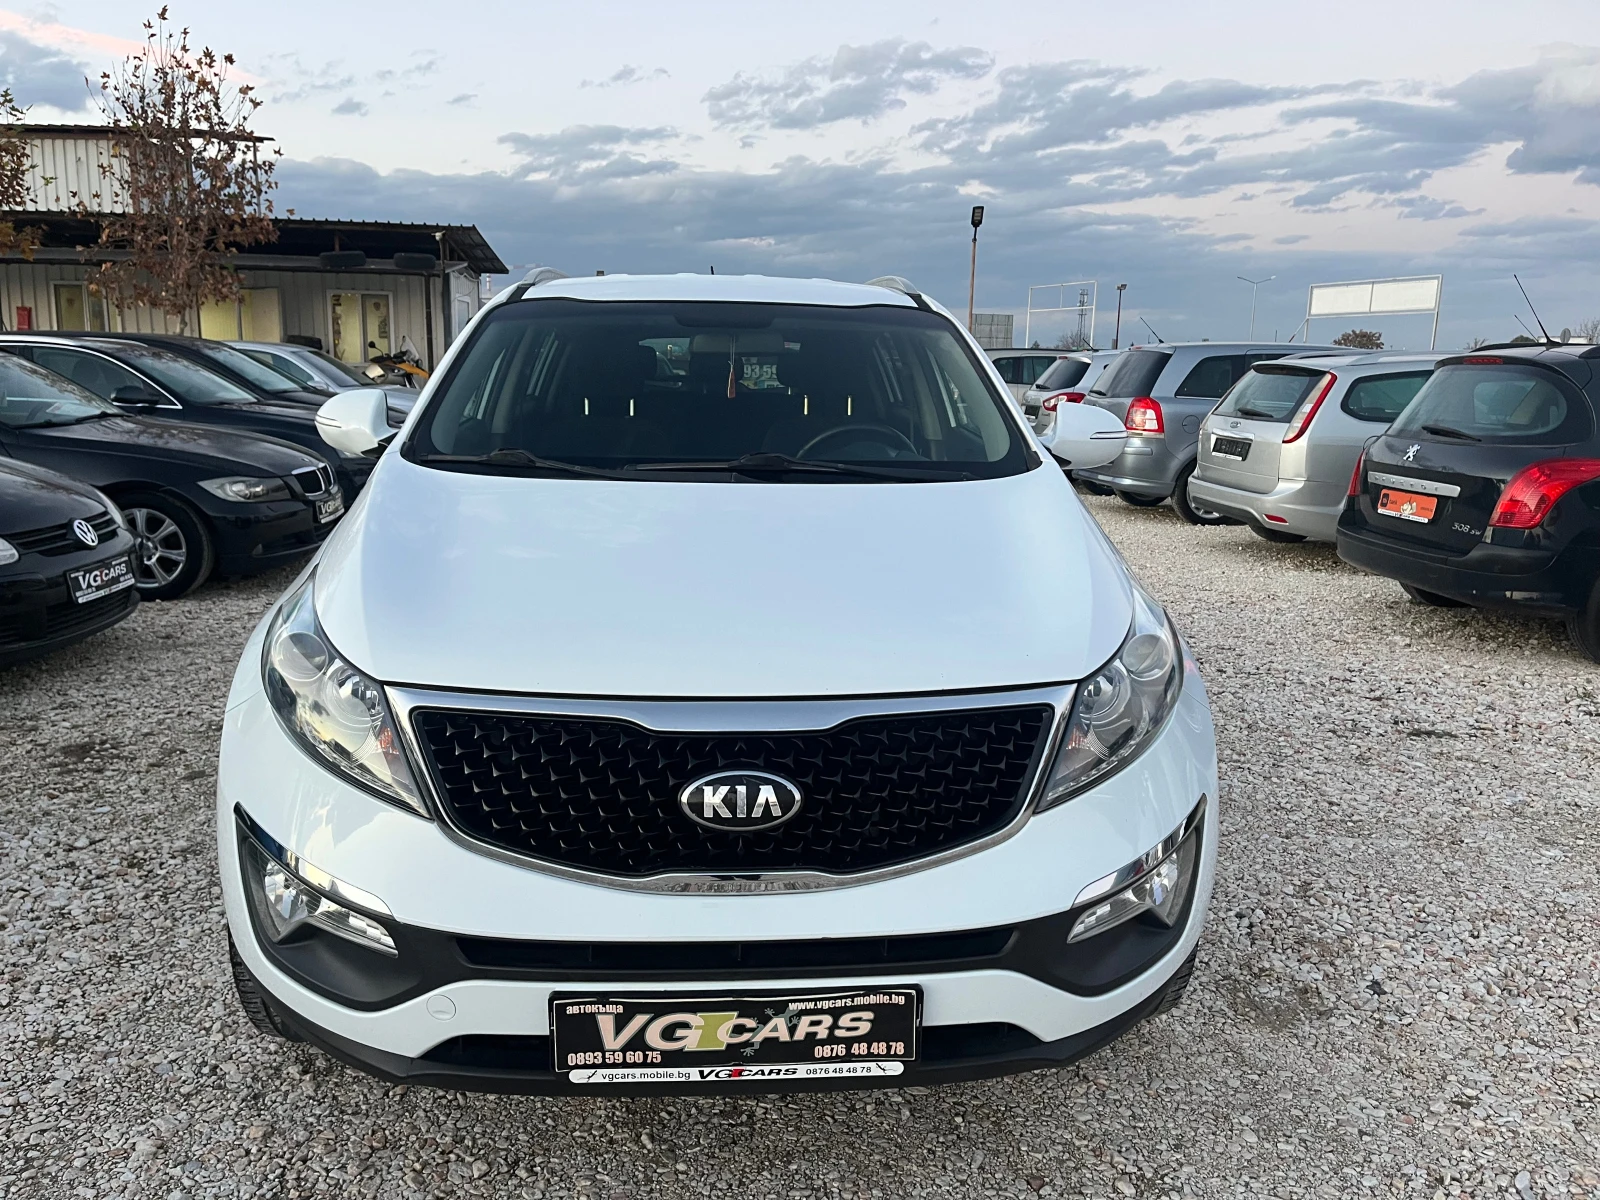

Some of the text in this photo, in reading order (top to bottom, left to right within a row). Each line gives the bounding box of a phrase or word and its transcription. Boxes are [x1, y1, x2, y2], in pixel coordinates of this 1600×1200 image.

[1451, 522, 1471, 533] 308
[702, 785, 782, 818] KIA
[566, 1004, 624, 1015] автокъща
[788, 993, 905, 1011] www.vgcars.mobile.bg
[814, 1041, 905, 1058] 0876 48 48 78
[567, 1051, 662, 1066] 0893 59 60 75
[601, 1069, 691, 1081] vgcars.mobile.bg
[806, 1067, 830, 1076] 0876
[831, 1066, 844, 1075] 48
[847, 1066, 859, 1074] 48
[860, 1066, 872, 1074] 78
